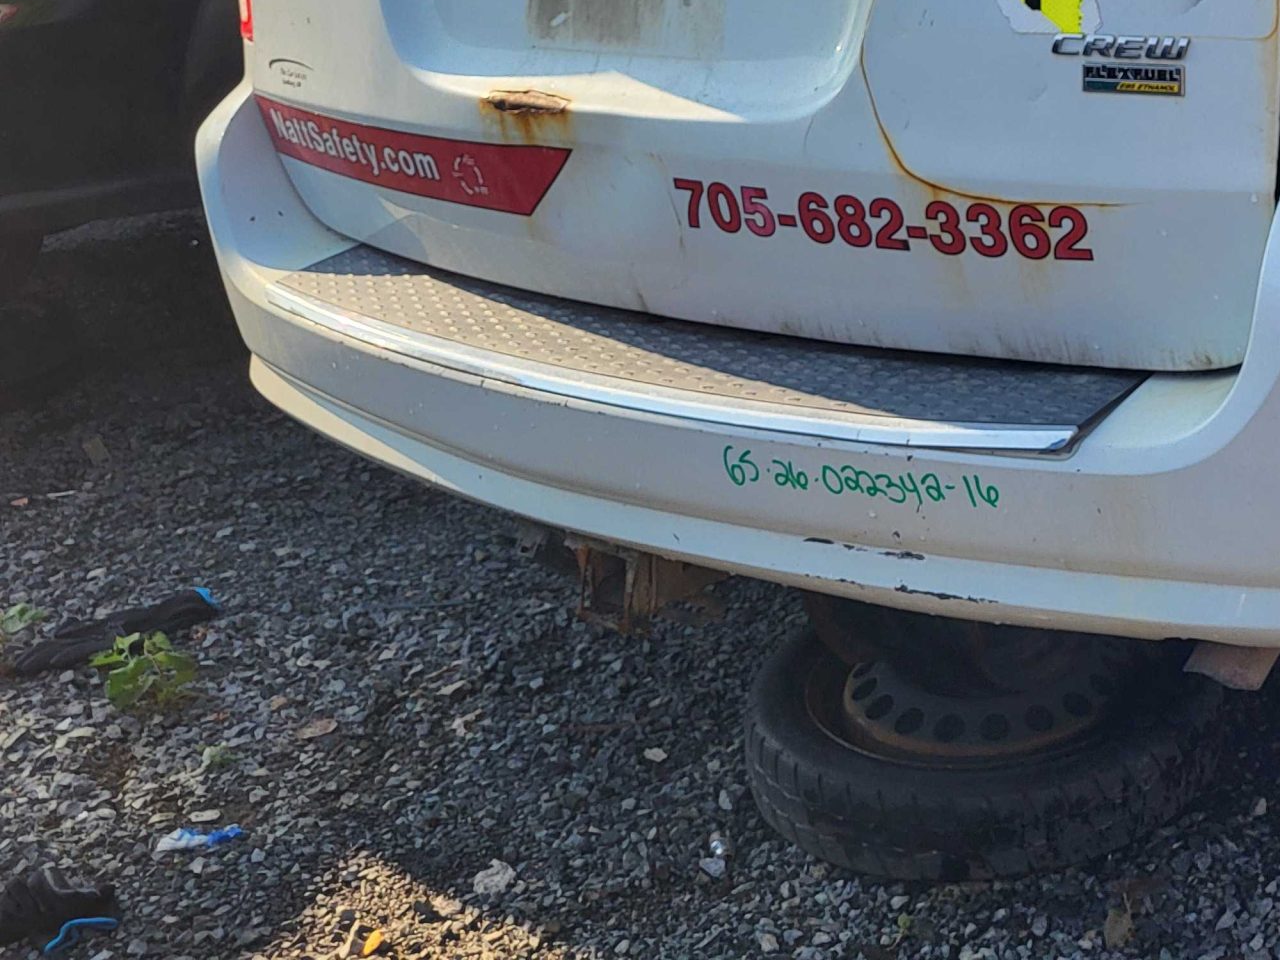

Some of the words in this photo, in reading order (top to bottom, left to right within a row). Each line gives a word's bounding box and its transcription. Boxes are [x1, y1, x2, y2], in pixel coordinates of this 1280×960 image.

[1052, 32, 1190, 60] CREW
[269, 108, 441, 181] NattSafety.com
[673, 177, 1095, 262] 705-682-3362
